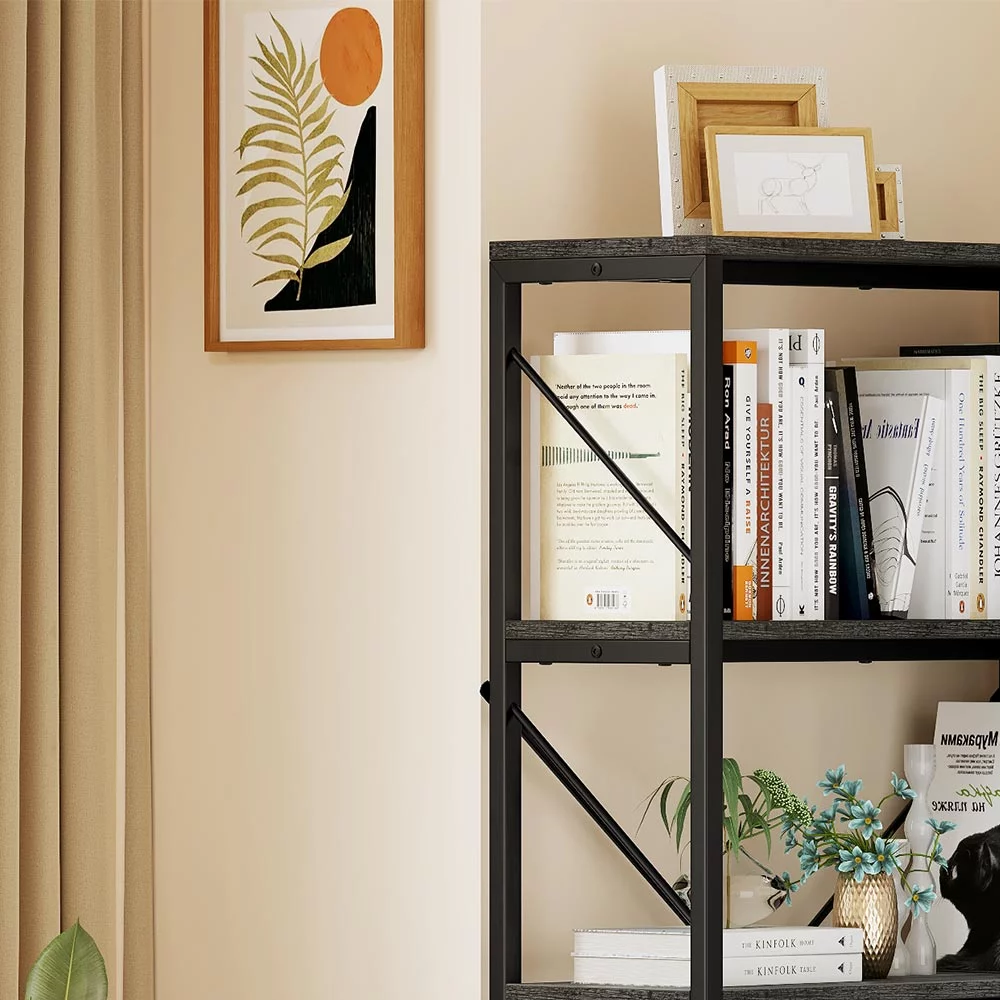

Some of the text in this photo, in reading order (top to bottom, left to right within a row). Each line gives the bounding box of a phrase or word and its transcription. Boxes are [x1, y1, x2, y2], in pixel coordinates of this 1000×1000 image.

[760, 417, 770, 588] INNENARCHITEKTUR
[958, 495, 965, 507] of
[829, 485, 837, 595] GRAVITY'S RAINBOW
[755, 938, 797, 949] KINFOLK
[757, 965, 797, 977] KINFOLK
